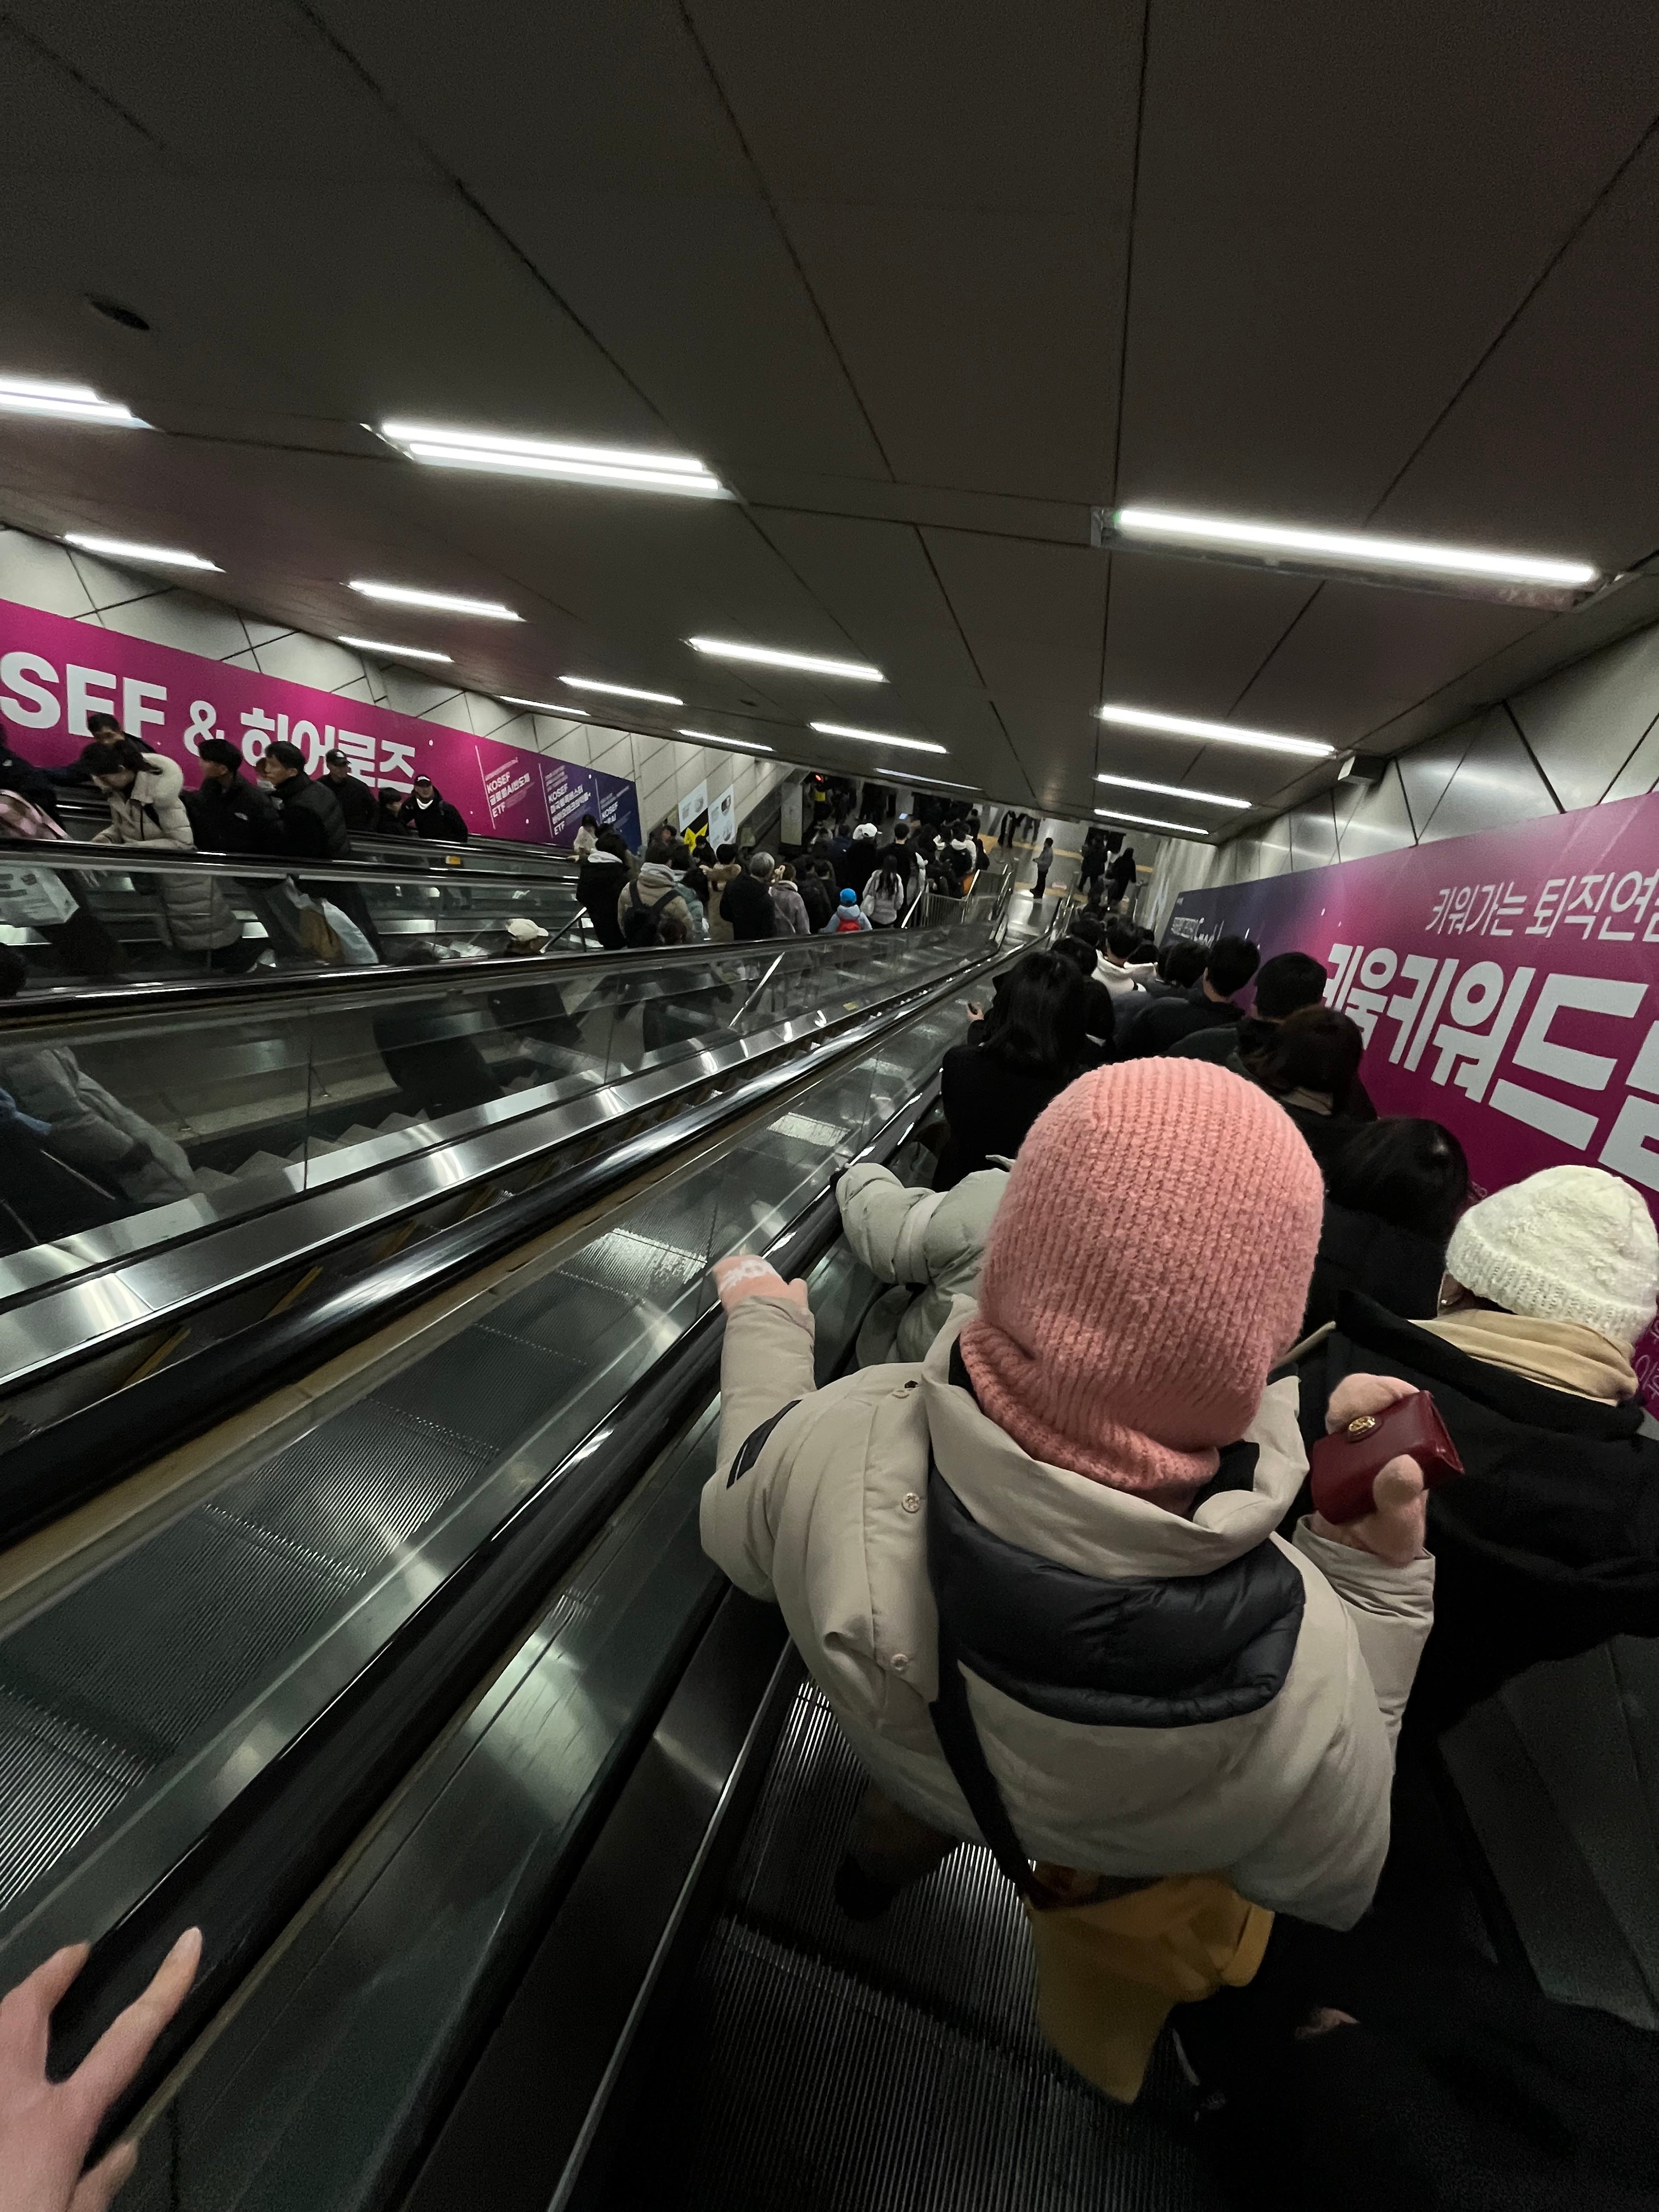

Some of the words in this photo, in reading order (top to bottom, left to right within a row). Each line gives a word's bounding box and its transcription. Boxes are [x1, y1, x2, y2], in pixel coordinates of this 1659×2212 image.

[240, 707, 415, 794] 히어로즈
[486, 771, 511, 794] KOSEF
[492, 802, 506, 818] ETF
[554, 821, 565, 835] ETF
[1425, 881, 1527, 936] 키워가는
[1322, 943, 1659, 1192] 키움키워드
